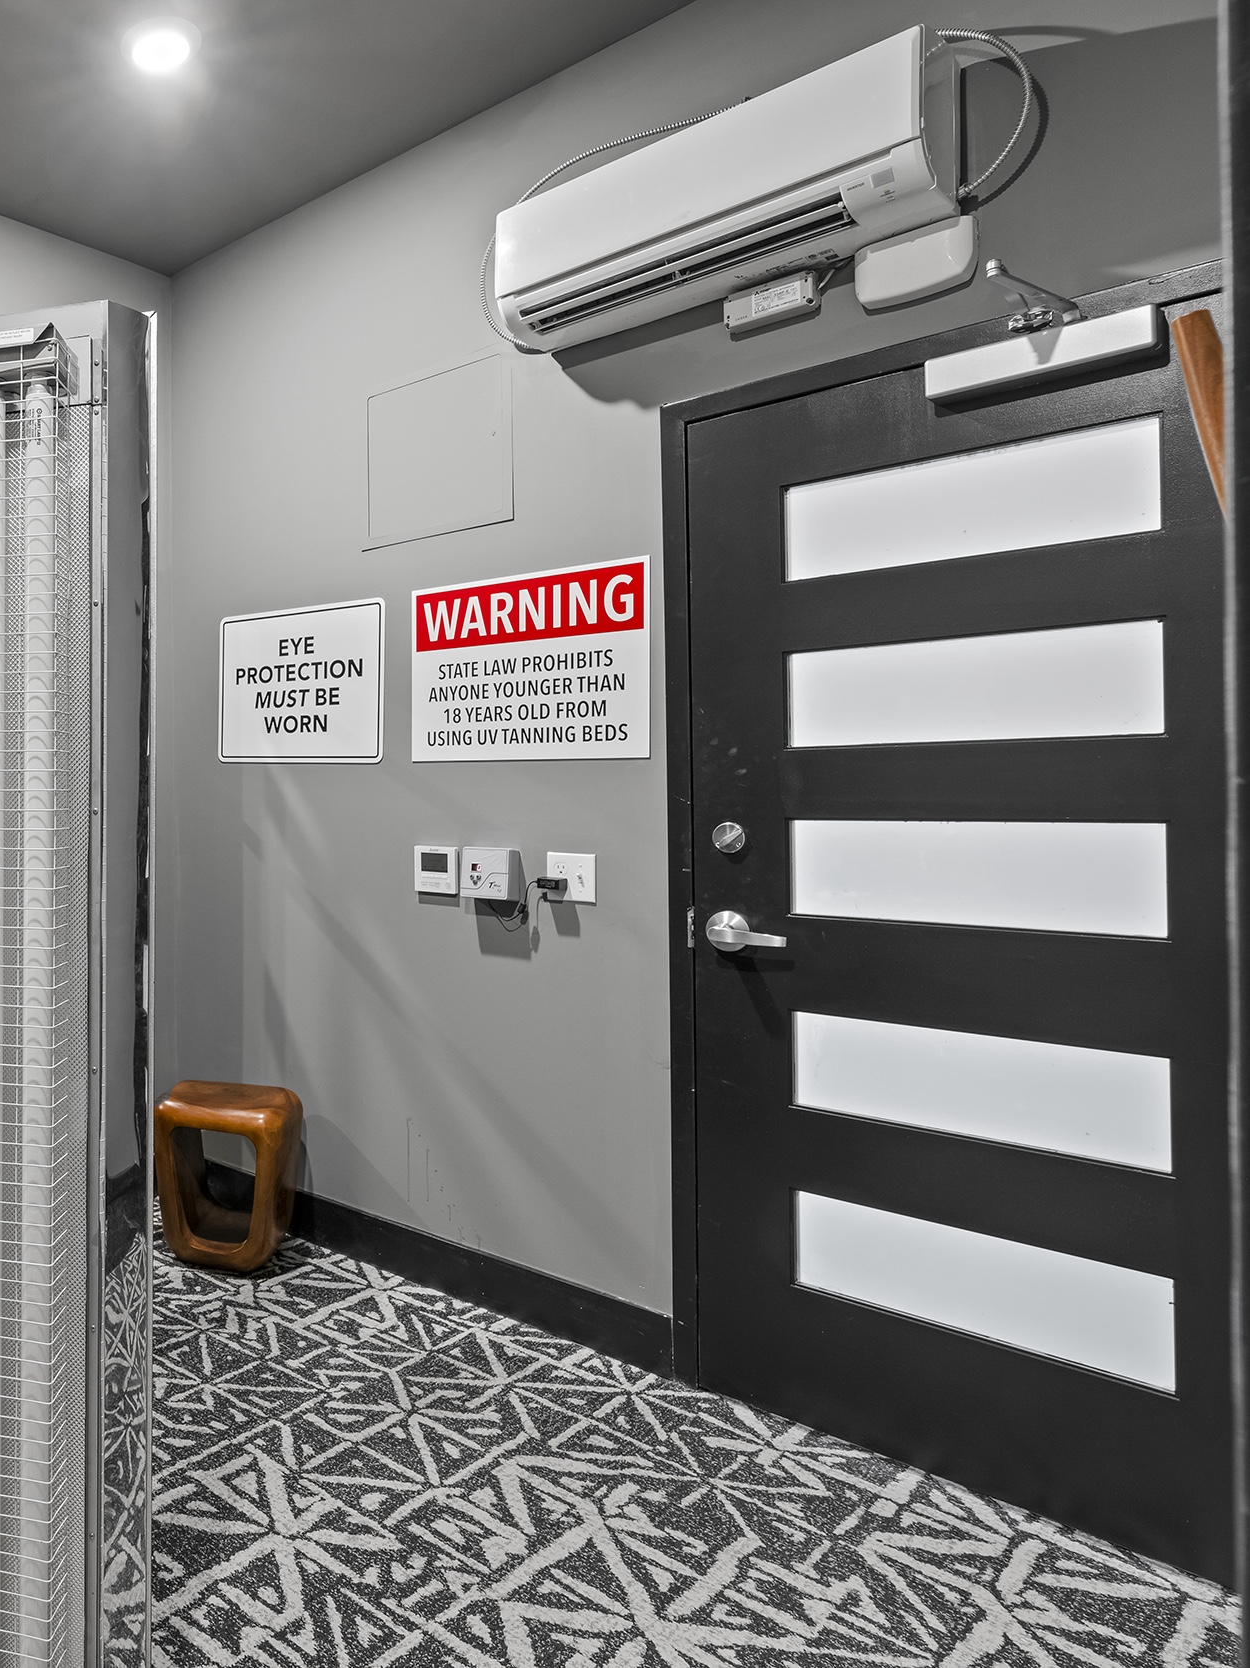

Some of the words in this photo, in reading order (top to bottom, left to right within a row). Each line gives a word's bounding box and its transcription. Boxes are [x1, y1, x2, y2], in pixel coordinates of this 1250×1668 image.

[423, 574, 635, 643] WARNING
[279, 636, 315, 657] EYE
[236, 658, 363, 685] PROTECTION
[438, 661, 479, 680] STATE
[483, 658, 517, 677] LAW
[522, 649, 614, 673] PROHIBITS
[255, 689, 310, 709] MUST
[315, 687, 340, 706] BE
[428, 683, 489, 703] ANYONE
[493, 677, 573, 699] YOUNGER
[576, 673, 626, 693] THAN
[264, 714, 328, 734] WORN
[443, 708, 462, 724] 18
[465, 705, 513, 723] YEARS
[517, 703, 551, 721] OLD
[556, 700, 607, 719] FROM
[427, 729, 473, 747] USING
[477, 728, 499, 746] UV
[501, 726, 576, 744] TANNING
[582, 723, 629, 742] BEDS
